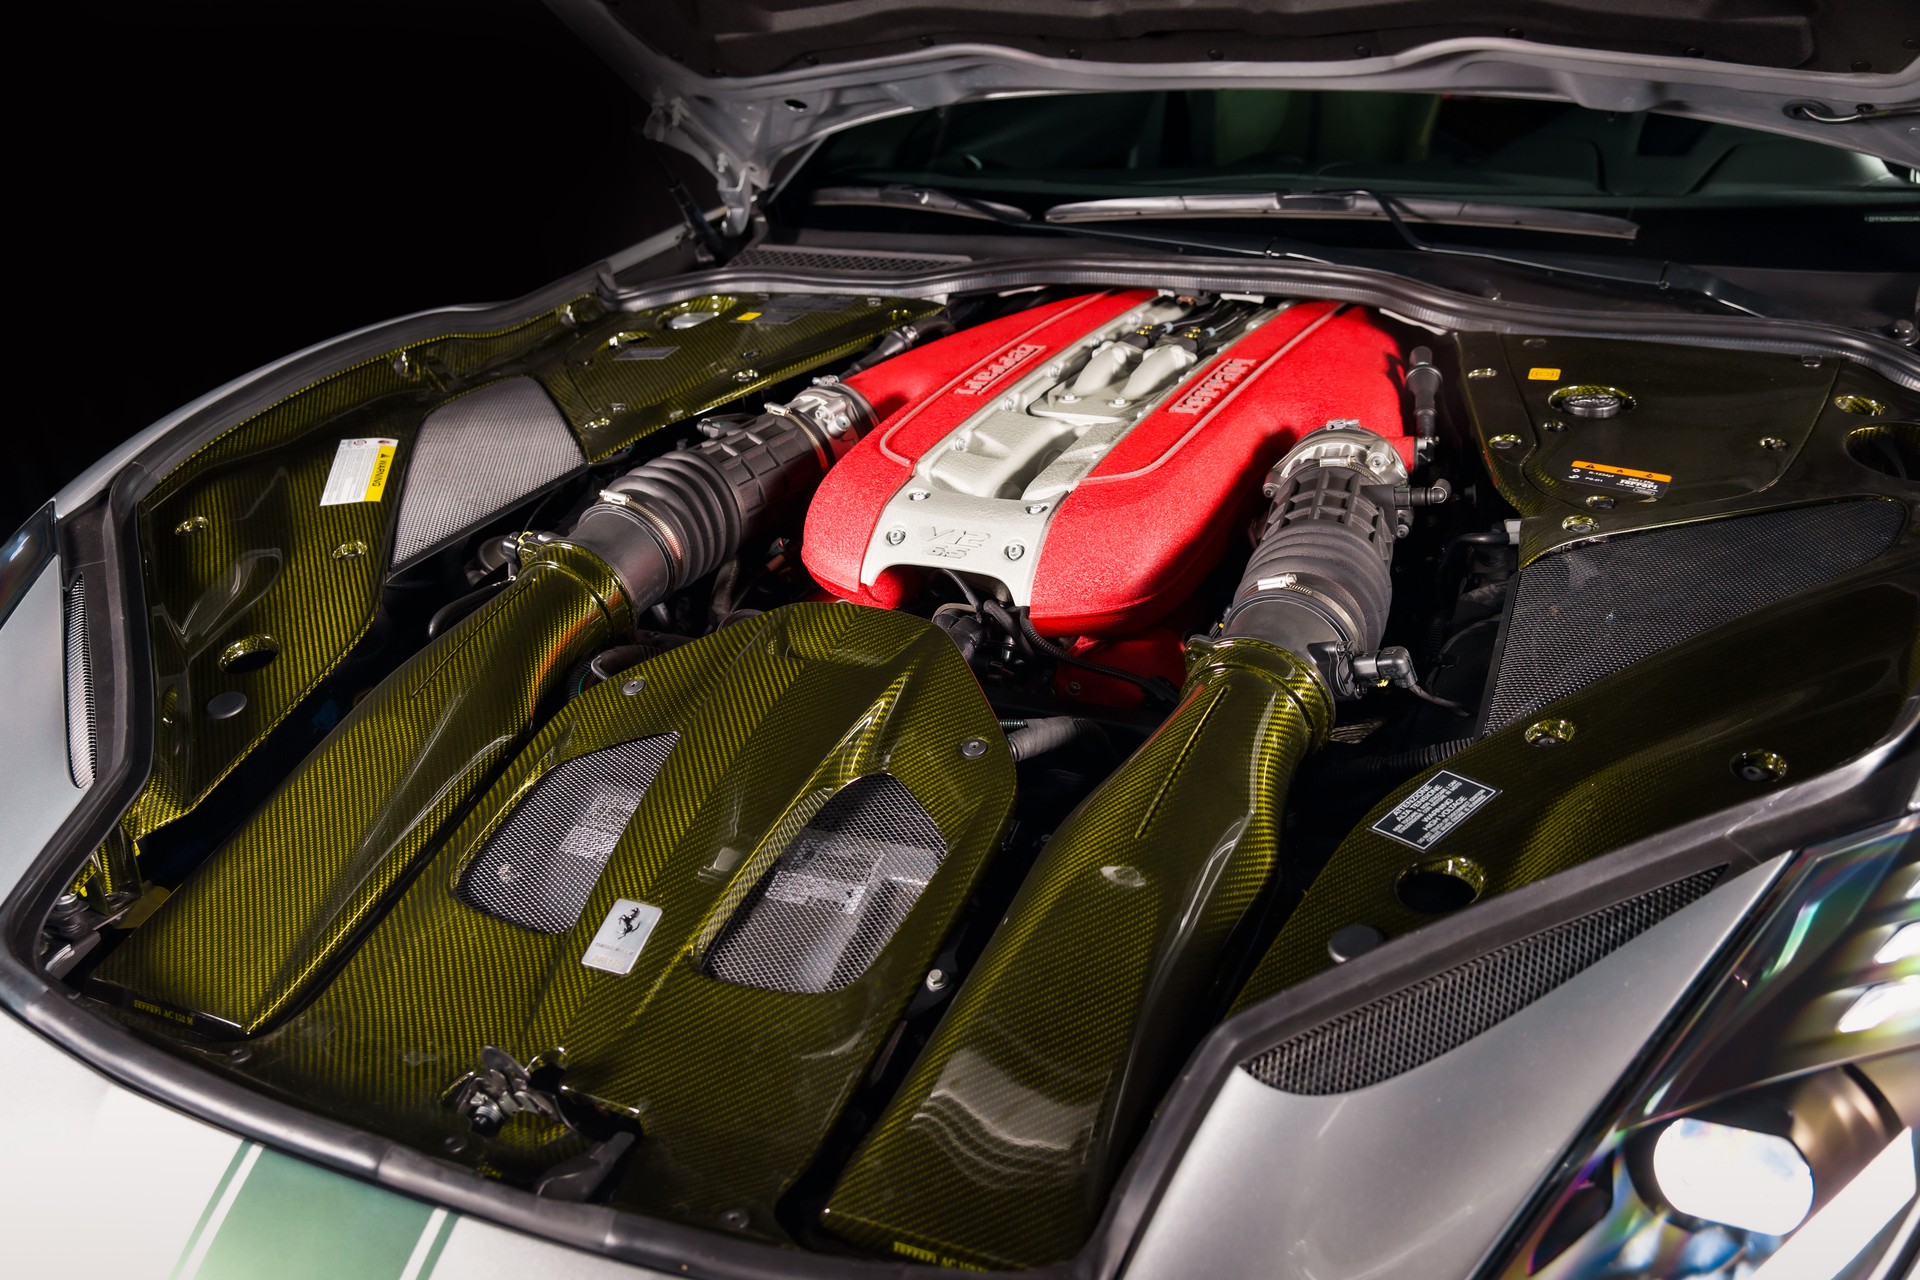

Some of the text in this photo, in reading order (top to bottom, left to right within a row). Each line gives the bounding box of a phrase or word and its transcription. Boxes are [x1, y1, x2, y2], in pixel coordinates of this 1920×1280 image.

[1167, 357, 1257, 416] Ferrari
[372, 459, 388, 487] WARNING
[1619, 479, 1658, 489] Ferrari
[926, 526, 991, 548] V12
[1392, 784, 1432, 816] ATTENZIONE
[1395, 784, 1442, 821] ALTA TENSIONE
[1421, 797, 1453, 823] WARNING
[1422, 795, 1467, 831] HIGH VOLTAGE
